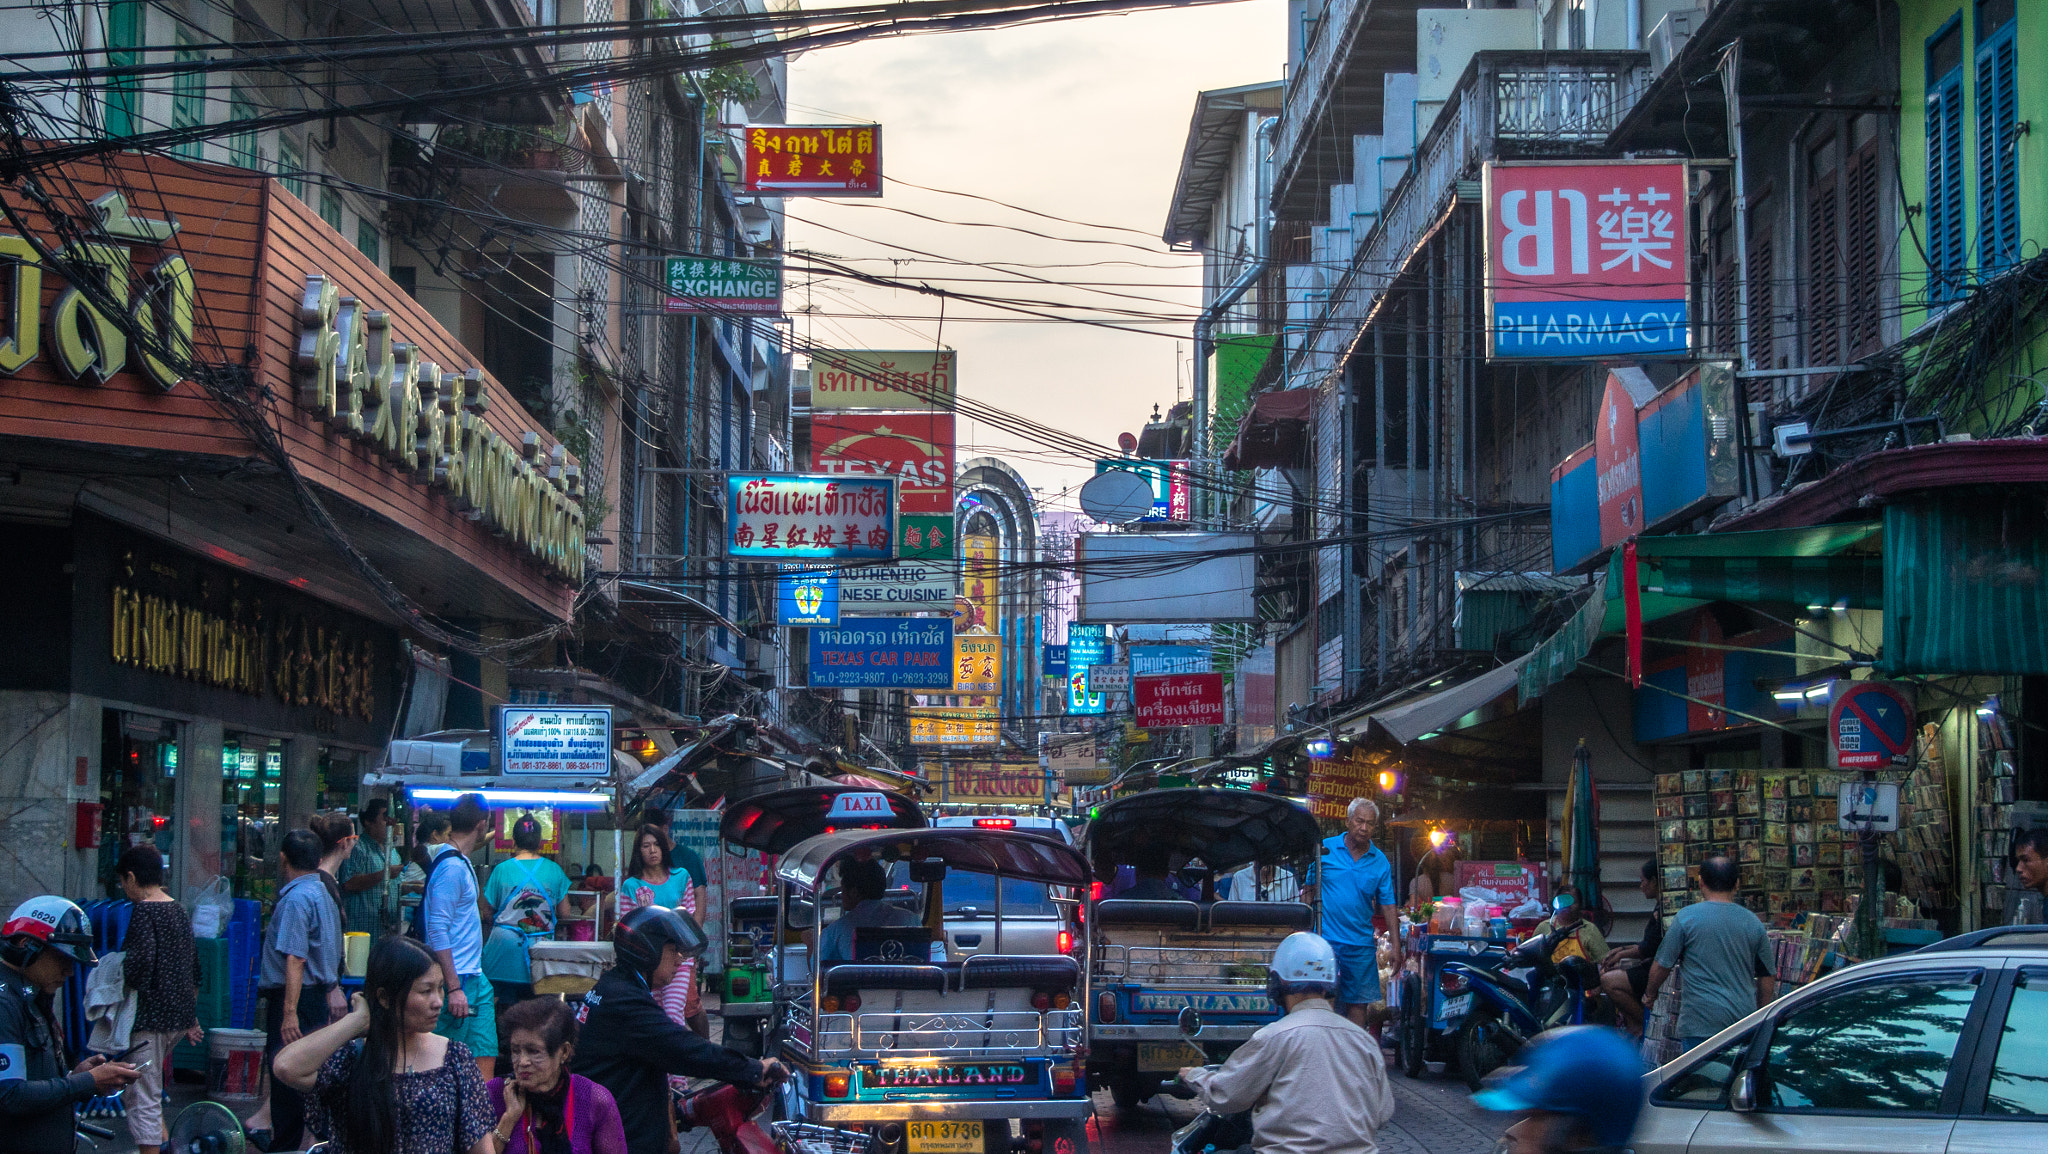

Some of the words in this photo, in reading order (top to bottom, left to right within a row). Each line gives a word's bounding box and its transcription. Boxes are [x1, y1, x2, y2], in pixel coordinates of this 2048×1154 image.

[1501, 189, 1589, 276] ยา
[1596, 187, 1675, 273] 藥
[671, 279, 777, 297] EXCHANGE
[1498, 311, 1681, 346] PHARMACY
[735, 478, 888, 518] เนื้อแพะเท็กซัส
[841, 568, 926, 580] AUTHENTIC
[886, 588, 948, 600] CUISINE
[892, 621, 945, 645] เท็กซัส
[960, 638, 996, 653] รังนก
[822, 651, 864, 666] TEXAS
[870, 651, 898, 666] CAR
[904, 651, 940, 666] PARK
[1050, 650, 1066, 659] LH
[892, 672, 949, 684] 0-2623-3298
[957, 682, 975, 691] BIRD
[977, 682, 997, 691] NEST
[1154, 681, 1203, 697] เท็กซัส
[1137, 699, 1221, 717] เครื่องเขียน
[841, 796, 883, 811] TAXI
[31, 909, 56, 924] 6629
[1139, 995, 1270, 1011] THAILAND
[875, 1066, 1025, 1085] THAILAND
[941, 1123, 981, 1139] 3736
